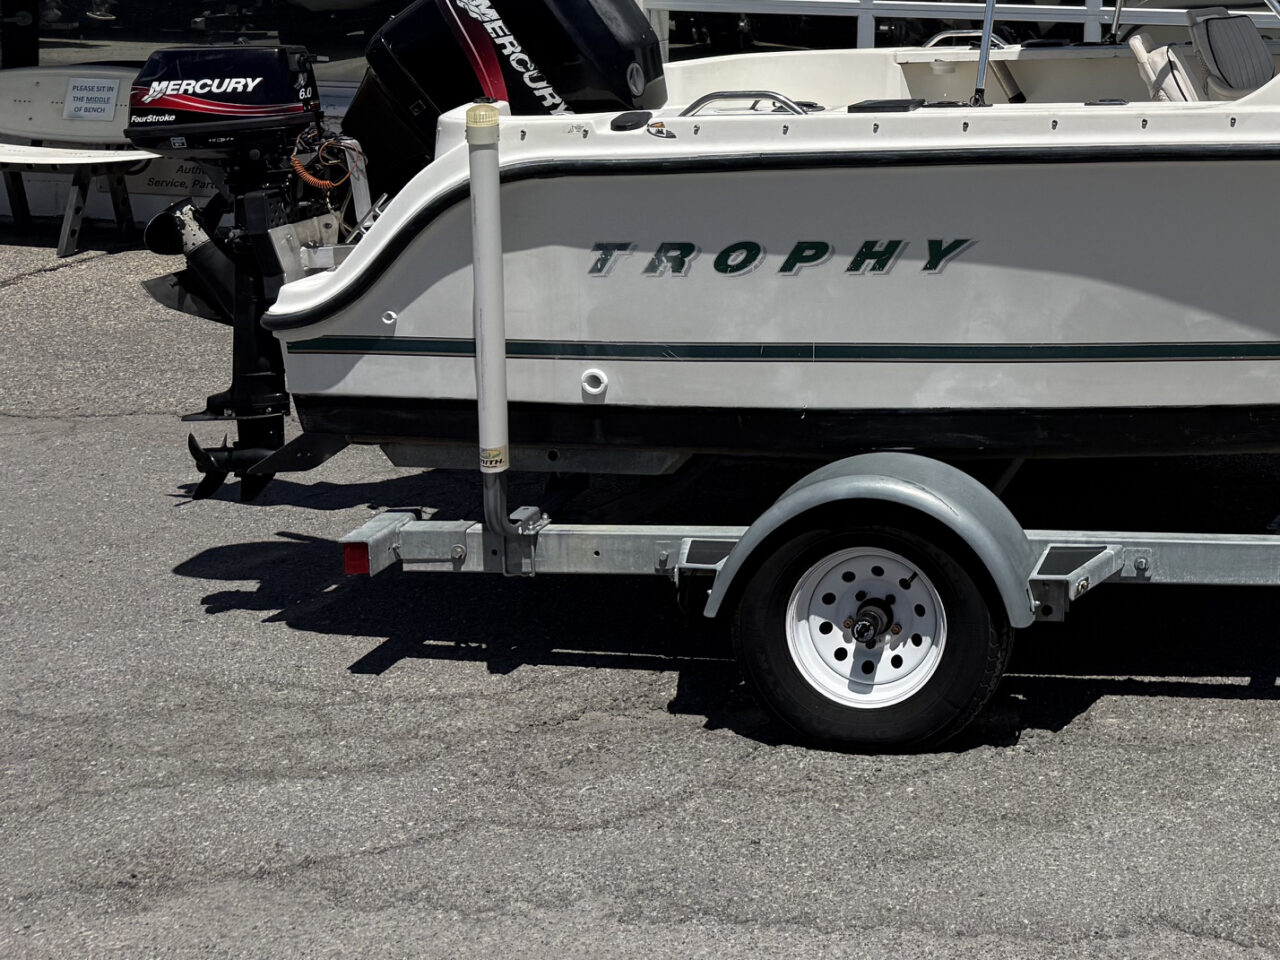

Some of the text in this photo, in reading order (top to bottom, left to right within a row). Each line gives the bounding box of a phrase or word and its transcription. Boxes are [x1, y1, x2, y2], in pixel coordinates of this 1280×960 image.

[72, 85, 95, 93] PLEASE
[143, 77, 263, 103] MERCURY
[299, 88, 312, 100] 6.0
[85, 96, 111, 104] MIDDLE
[130, 114, 176, 124] FourStroke
[176, 164, 207, 175] Auth
[147, 178, 188, 189] Service,
[587, 239, 979, 278] TROPHY
